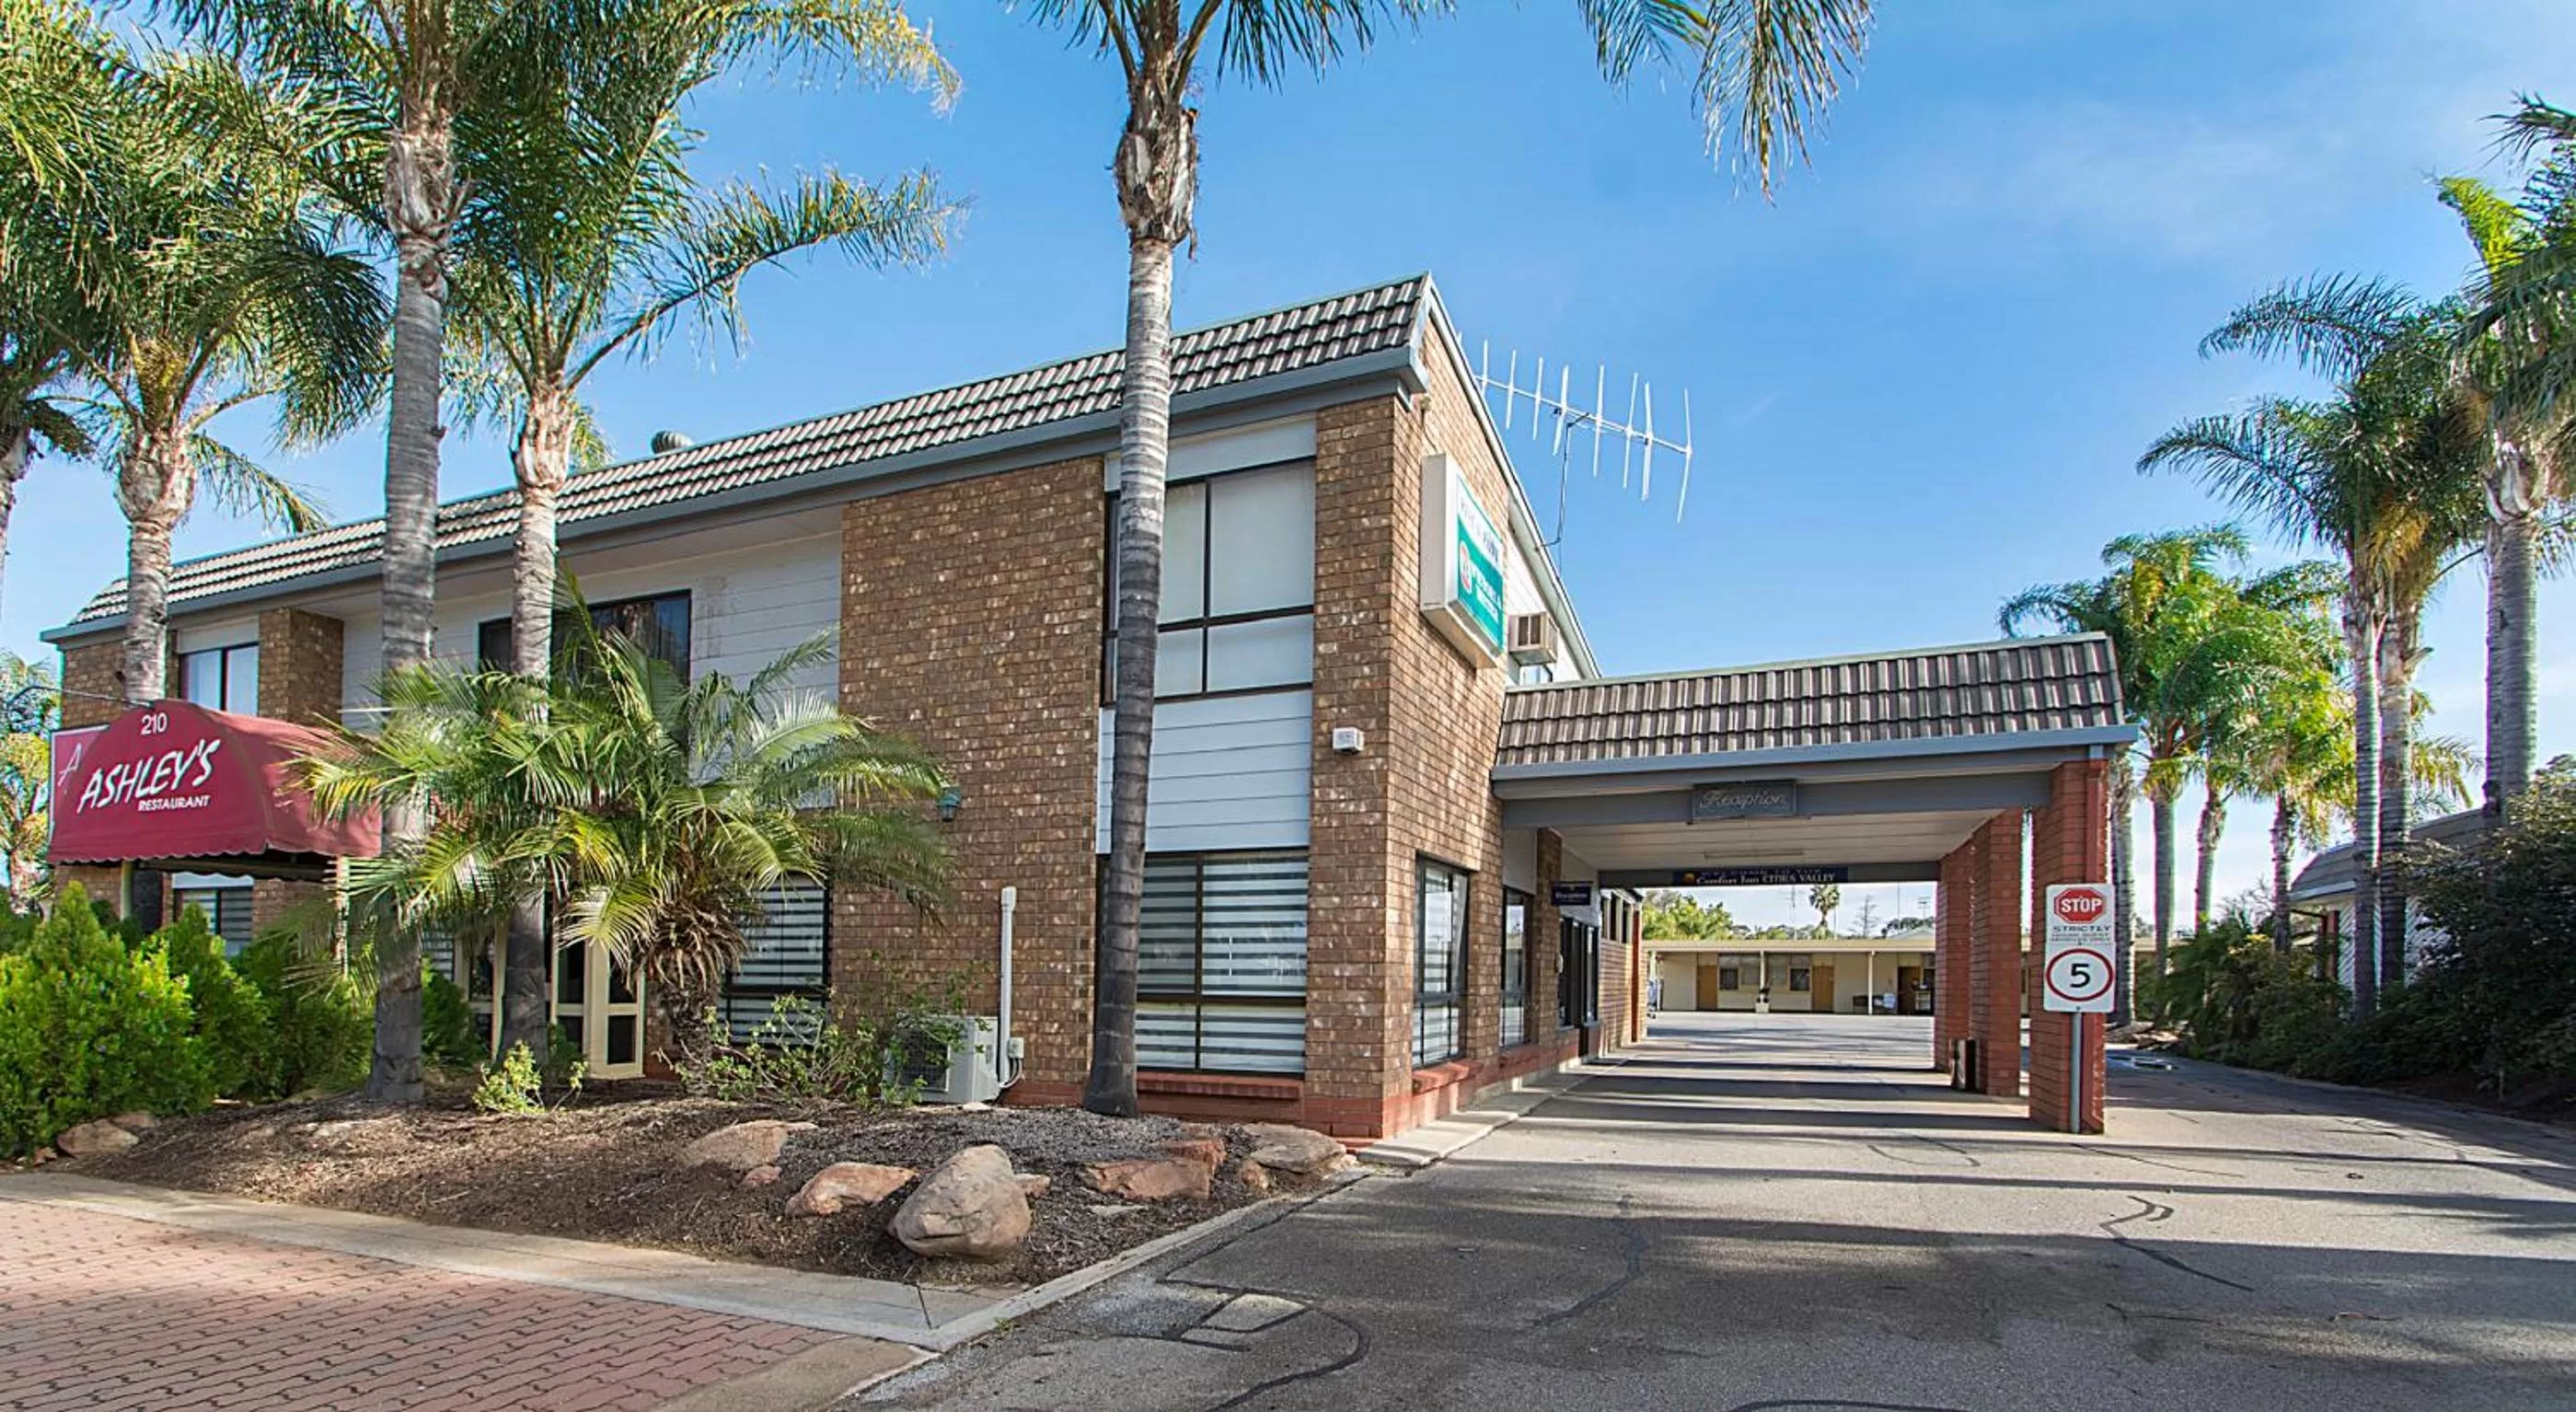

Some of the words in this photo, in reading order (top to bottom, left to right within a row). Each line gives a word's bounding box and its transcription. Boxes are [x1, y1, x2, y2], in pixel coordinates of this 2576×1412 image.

[141, 712, 168, 736] 210
[76, 738, 221, 814] ASHLEY'S
[138, 794, 211, 812] RESTAURANT
[1696, 875, 1738, 885] Comfort
[1740, 874, 1760, 884] Inn
[2061, 897, 2103, 913] STOP
[2070, 963, 2091, 989] 5
